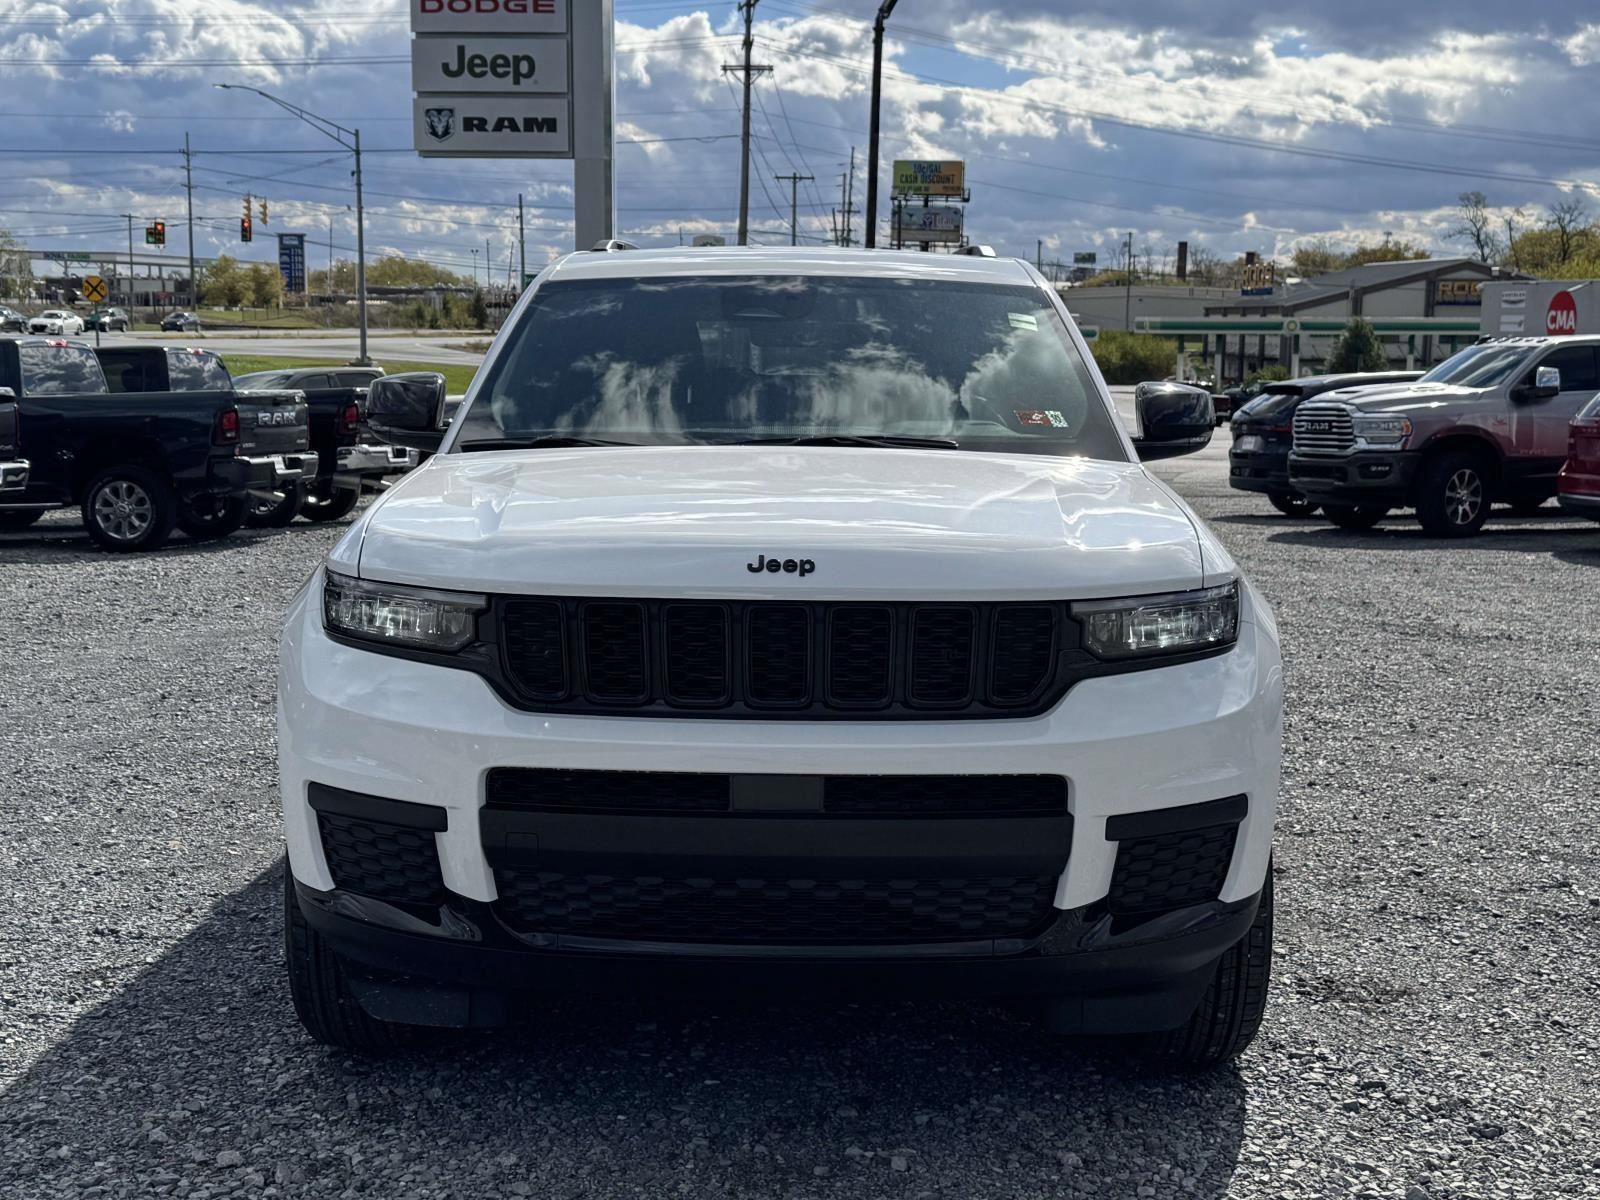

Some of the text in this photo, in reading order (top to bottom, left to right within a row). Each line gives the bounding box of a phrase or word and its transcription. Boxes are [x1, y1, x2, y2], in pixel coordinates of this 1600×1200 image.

[420, 0, 556, 14] DODGE
[441, 45, 536, 86] Jeep
[462, 117, 557, 133] RAM
[899, 173, 955, 184] CASH DISCOUNT
[1547, 310, 1576, 330] CMA
[257, 411, 297, 426] RAM
[1304, 422, 1329, 430] RAM
[746, 554, 816, 577] Jeep
